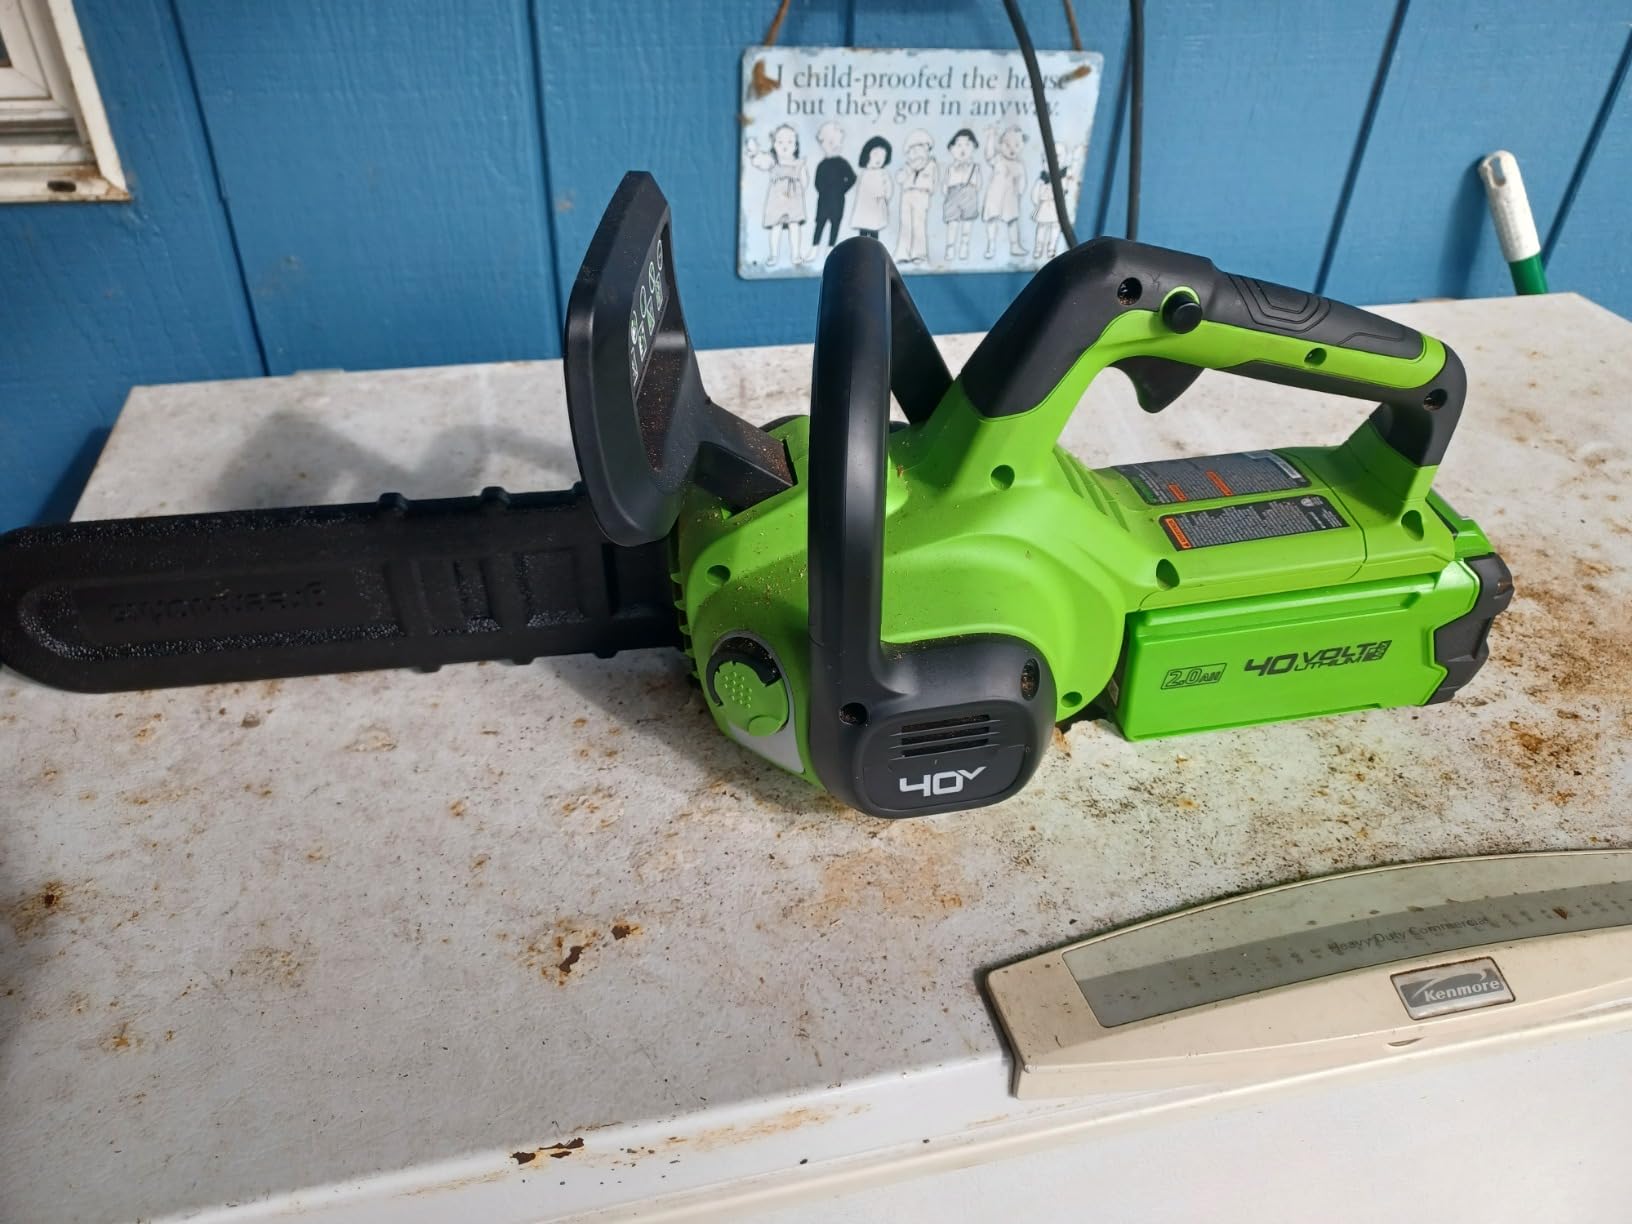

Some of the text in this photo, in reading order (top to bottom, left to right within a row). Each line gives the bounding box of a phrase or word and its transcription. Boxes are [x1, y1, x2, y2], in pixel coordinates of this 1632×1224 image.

[793, 63, 952, 96] child-proofed
[962, 65, 998, 90] the
[786, 92, 824, 116] but
[836, 92, 886, 122] they
[895, 97, 930, 125] got
[940, 94, 962, 117] in
[1244, 653, 1298, 677] 40
[1303, 642, 1378, 664] VOLT
[1375, 931, 1406, 946] Duty
[1424, 979, 1501, 1003] Kenmore
